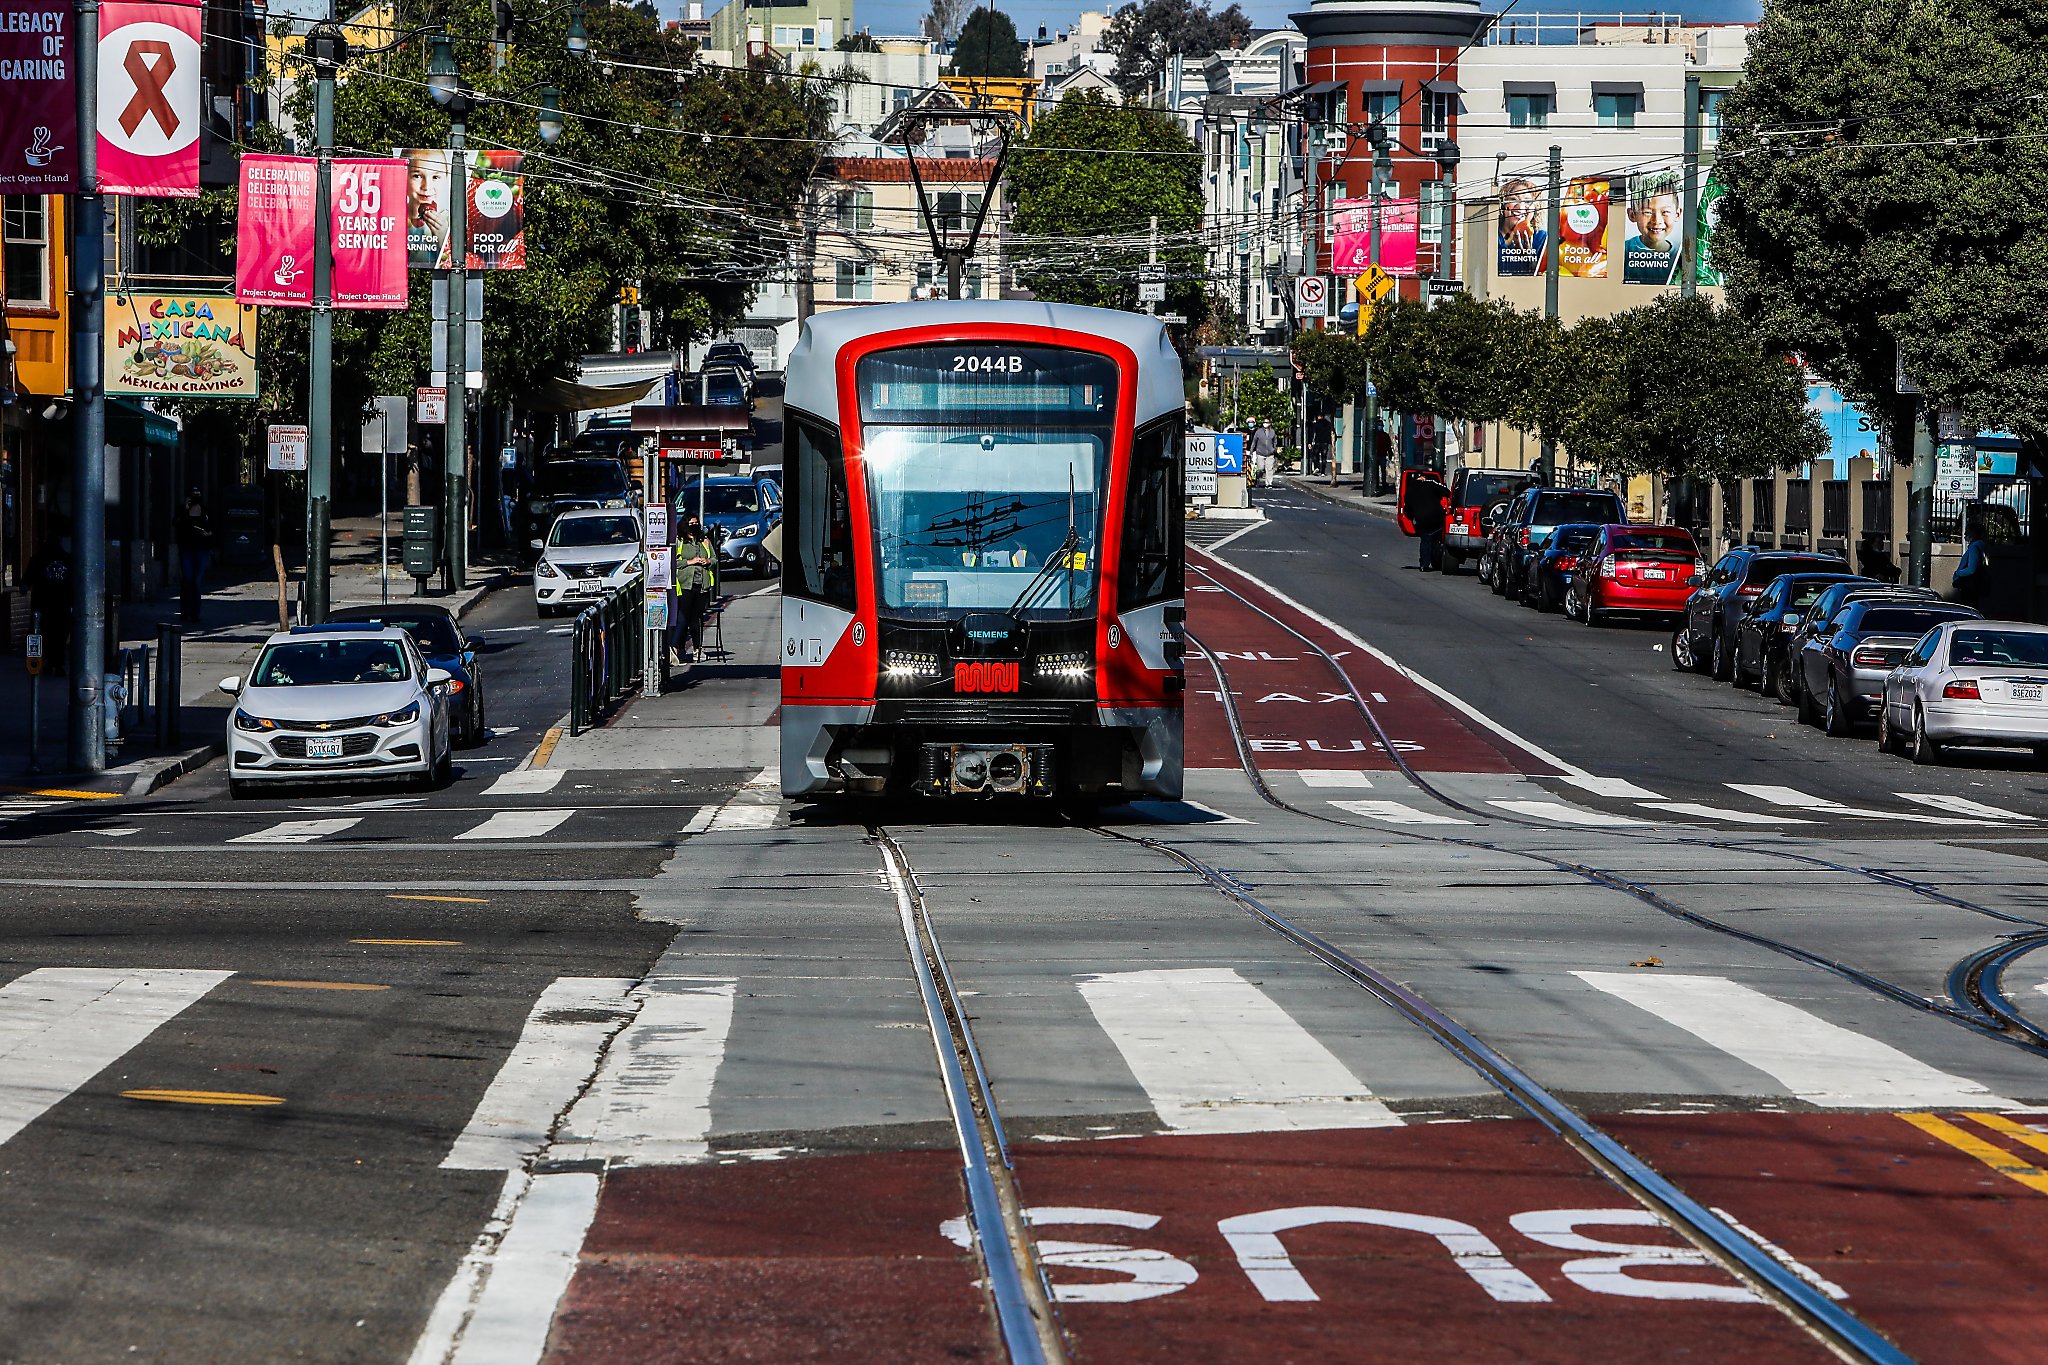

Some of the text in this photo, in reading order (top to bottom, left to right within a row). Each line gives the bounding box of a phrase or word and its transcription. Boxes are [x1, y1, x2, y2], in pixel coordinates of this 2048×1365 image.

[0, 12, 64, 33] LEGACY
[42, 36, 65, 56] OF
[0, 59, 65, 80] CARING
[17, 174, 41, 184] Open
[44, 173, 69, 182] Hand
[248, 168, 310, 182] CELEBRATING
[247, 182, 310, 196] CELEBRATING
[339, 171, 380, 214] 35
[247, 196, 309, 210] CELEBRATING
[1381, 206, 1400, 214] FOOD
[338, 216, 396, 231] YEARS OF
[1381, 223, 1415, 232] MEDICINE
[337, 233, 389, 249] SERVICE
[407, 234, 439, 243] OD FOR
[473, 233, 503, 243] FOOD
[407, 244, 437, 252] ARNING
[473, 239, 519, 253] FOR all
[1564, 246, 1590, 254] FOOD
[1564, 252, 1603, 264] FOR all
[1628, 251, 1653, 259] FOOD
[1628, 260, 1669, 268] GROWING
[242, 288, 306, 299] Project Open Hand
[337, 292, 359, 301] Project
[359, 293, 381, 301] Open
[150, 299, 214, 320] CASA
[118, 319, 246, 350] MEXICANA
[953, 355, 1023, 373] 2044B
[119, 373, 245, 391] MEXICAN CRAVINGS
[280, 434, 305, 443] STOPPING
[280, 444, 295, 452] ANY
[1190, 441, 1206, 452] NO
[1941, 447, 1948, 457] 2
[280, 452, 296, 461] TIME
[685, 450, 715, 459] METRO
[967, 630, 1009, 639] SIEMENS
[954, 662, 1019, 693] MUNI
[1195, 690, 1389, 704] TAXI
[1248, 739, 1426, 753] BUS
[938, 1205, 1851, 1304] BUS
